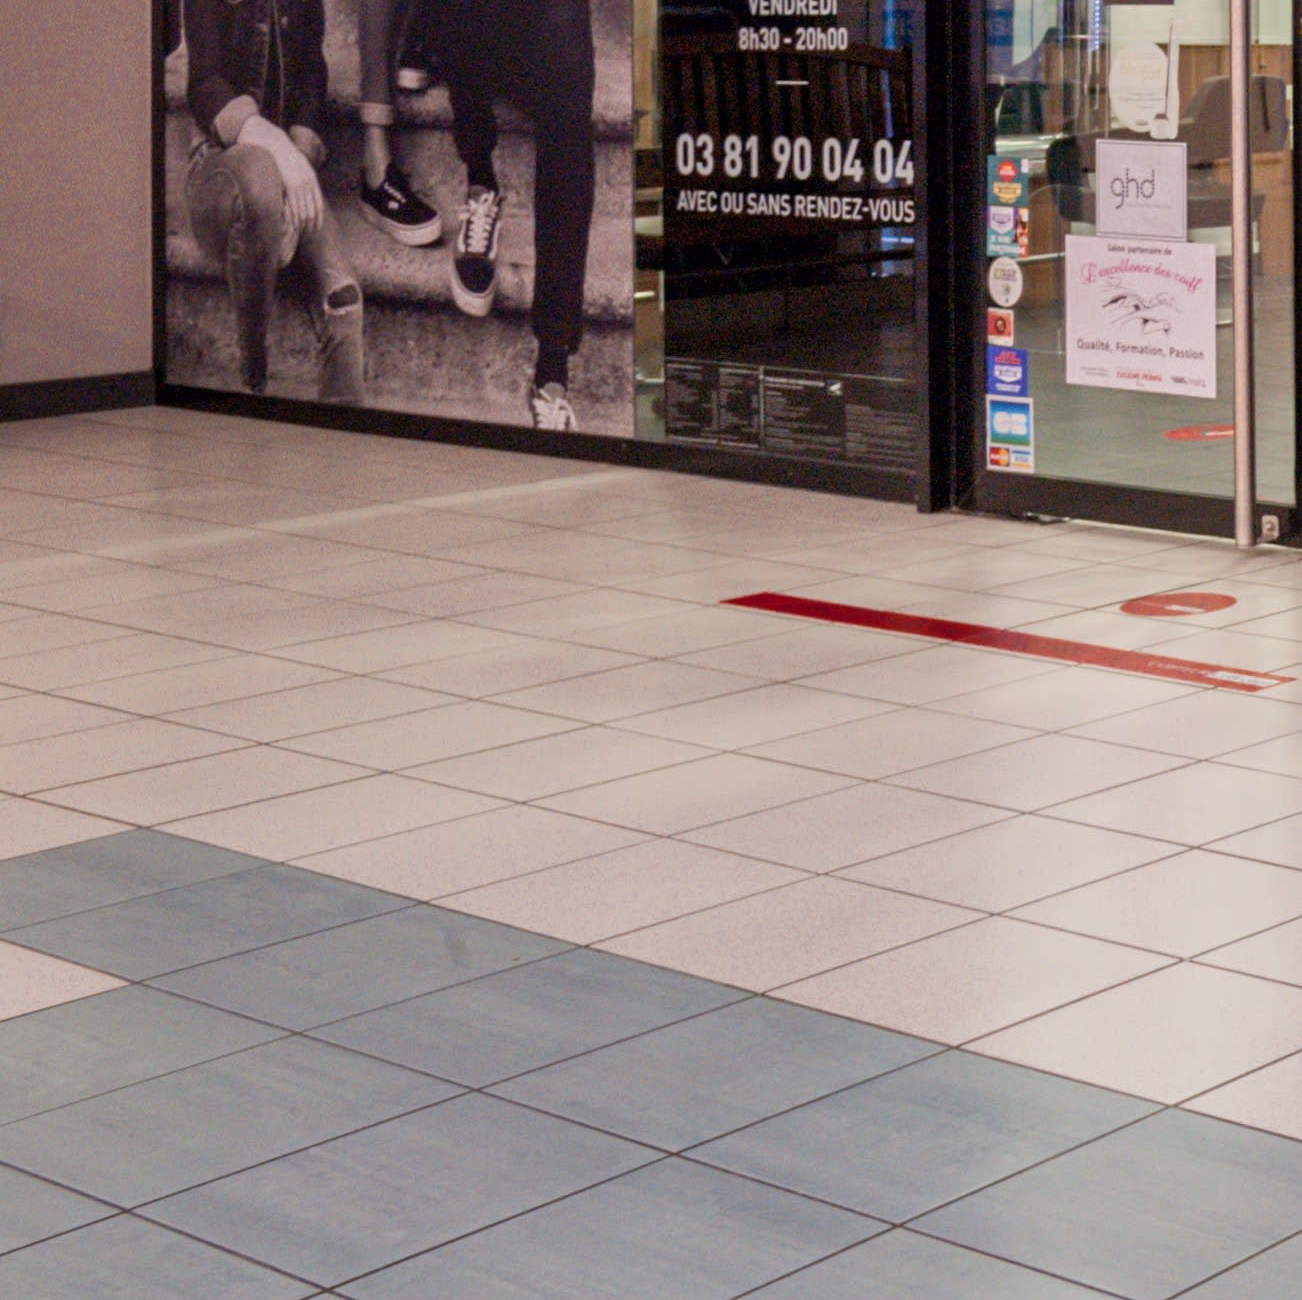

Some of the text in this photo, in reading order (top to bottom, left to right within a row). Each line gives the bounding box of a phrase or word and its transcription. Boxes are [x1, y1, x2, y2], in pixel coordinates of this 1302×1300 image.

[738, 27, 780, 50] 8h30
[796, 27, 848, 50] 20h00
[677, 133, 915, 185] 03 81 90 04 04
[1110, 167, 1155, 210] ghd
[677, 190, 915, 223] AVEC OU SANS RENDEZ-VOUS
[1164, 247, 1172, 255] de
[1116, 341, 1166, 359] Formation,
[1169, 346, 1204, 361] Passion
